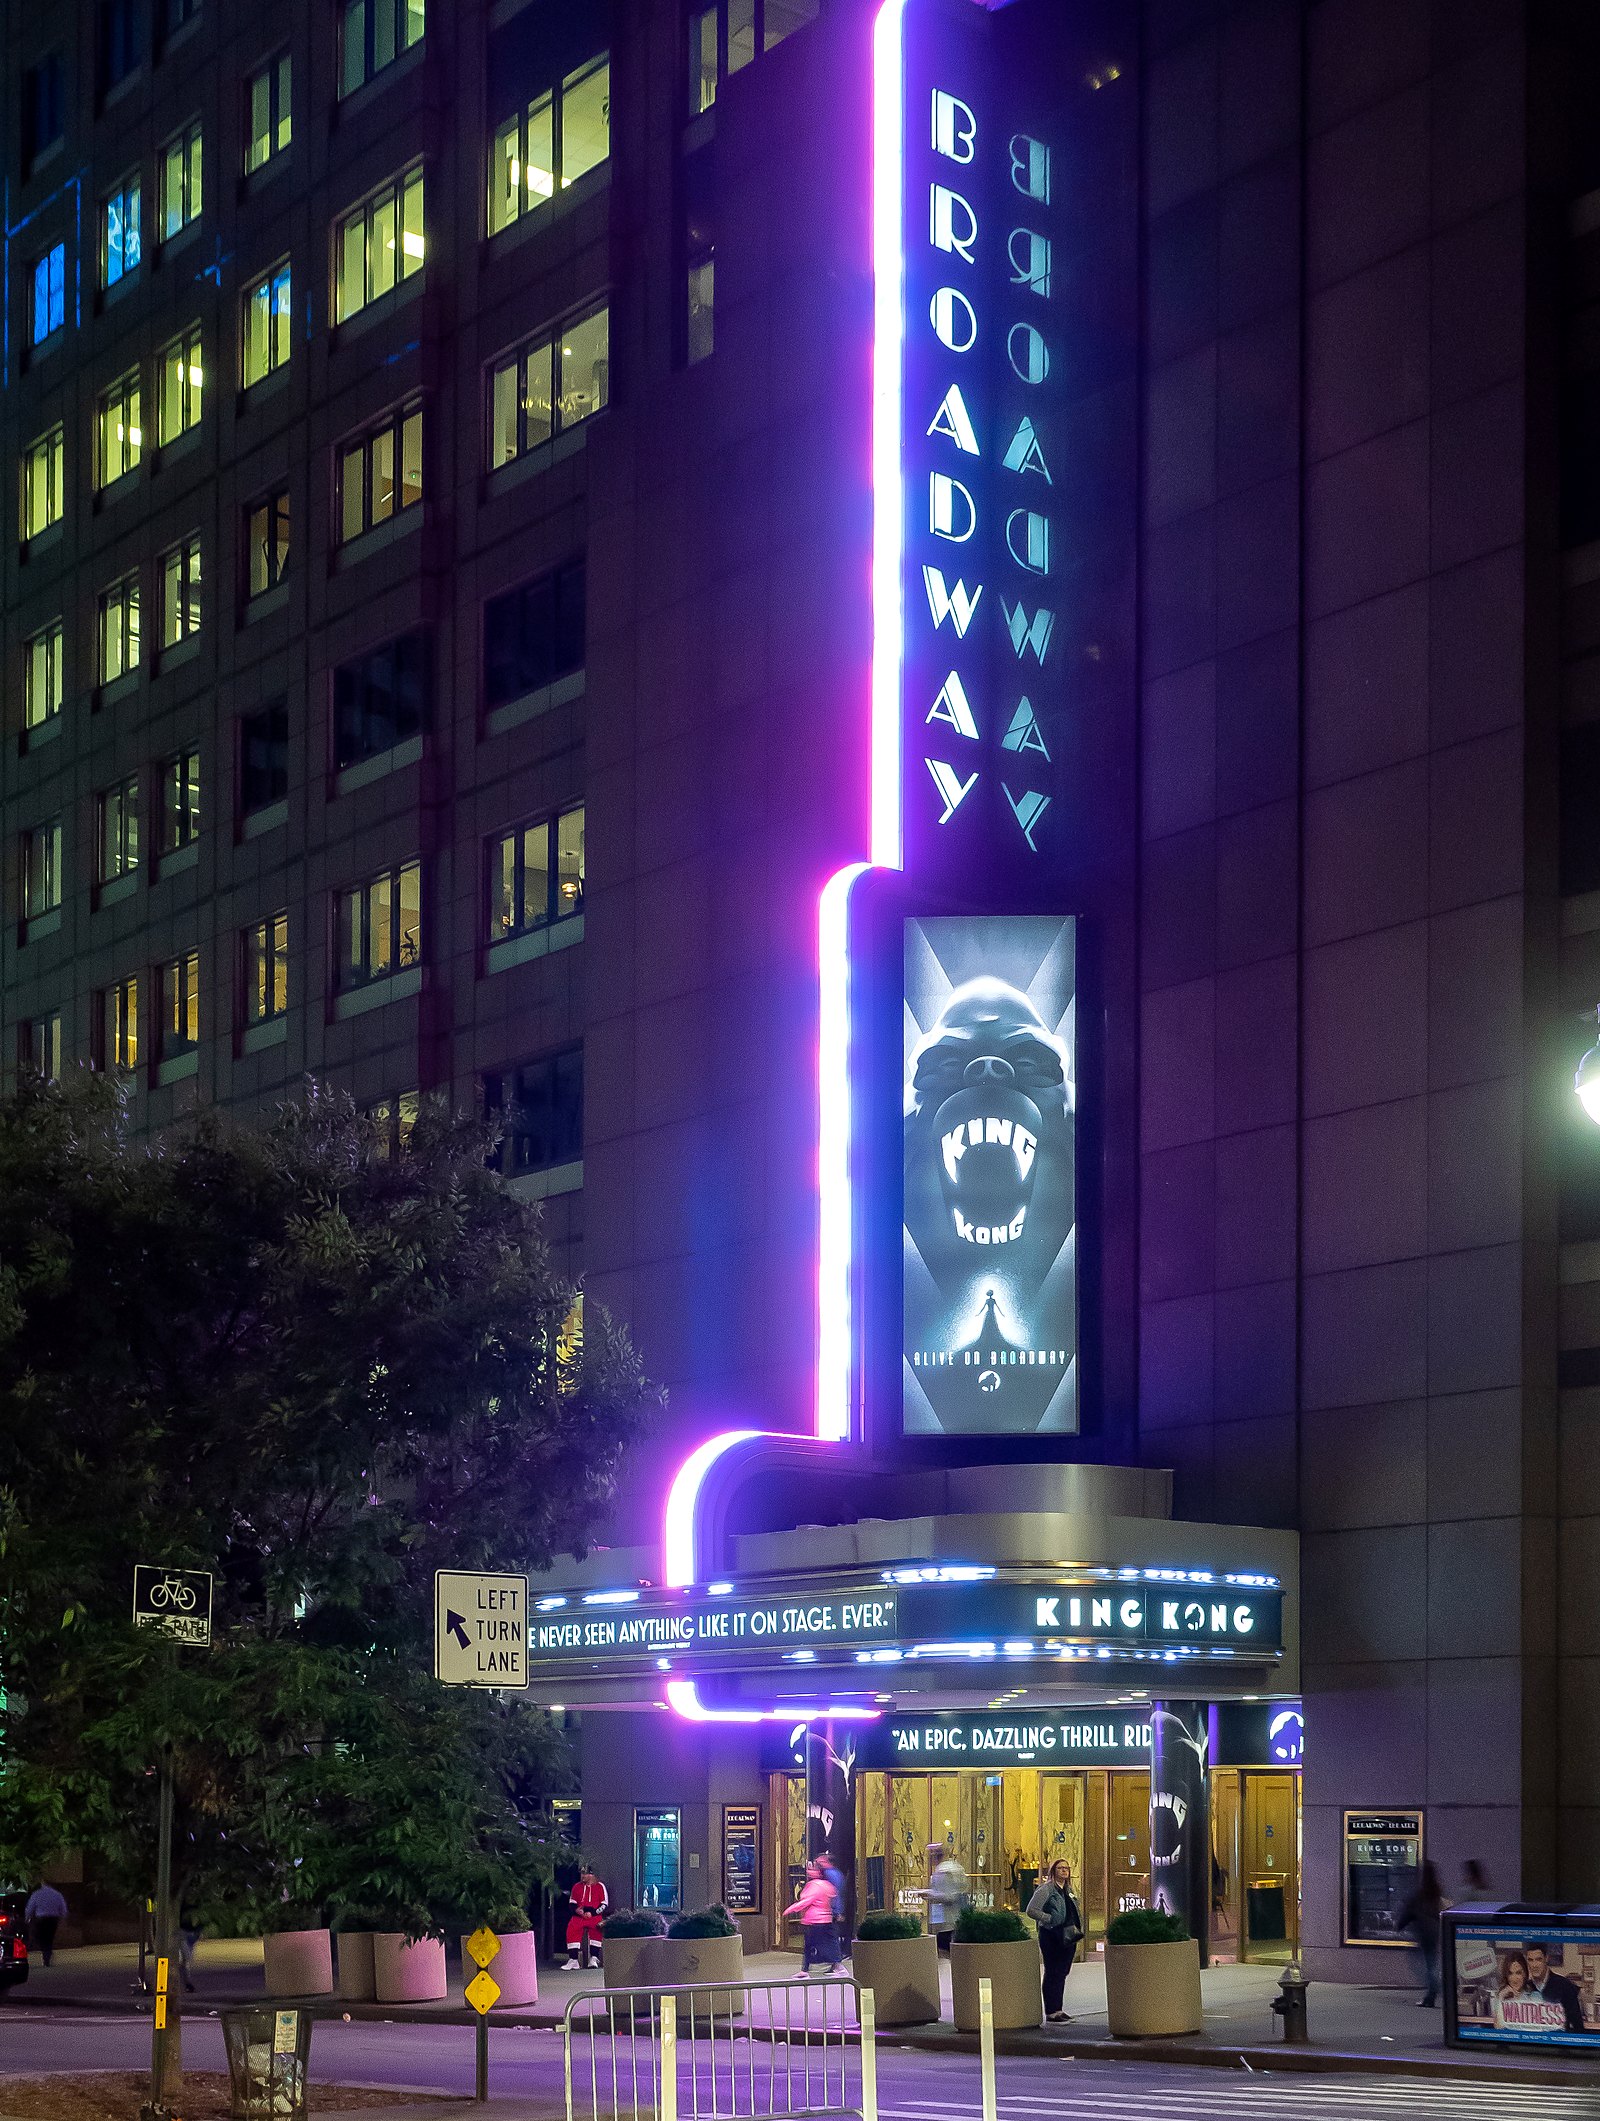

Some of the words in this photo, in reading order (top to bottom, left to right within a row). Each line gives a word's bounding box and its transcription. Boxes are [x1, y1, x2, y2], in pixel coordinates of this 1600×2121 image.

[922, 87, 983, 825] BROADWAY
[941, 1116, 1037, 1184] KING
[953, 1205, 1026, 1245] KONG
[913, 1351, 954, 1366] ALIVE
[964, 1350, 981, 1366] ON
[990, 1350, 1066, 1366] BROADWAY
[477, 1589, 519, 1611] LEFT
[1036, 1597, 1143, 1629] KING
[1162, 1601, 1255, 1634] KONG
[476, 1619, 521, 1641] TURN
[540, 1623, 581, 1648] NEVER
[584, 1621, 615, 1645] SEEN
[619, 1616, 695, 1643] ANYTHING
[699, 1614, 729, 1637] LIKE
[733, 1612, 747, 1636] IT
[751, 1611, 778, 1635] ON
[782, 1606, 837, 1633] STAGE.
[477, 1650, 520, 1672] LANE
[925, 1728, 966, 1752] EPIC,
[972, 1726, 1056, 1750] DAZZLING
[1061, 1725, 1118, 1748] THRILL
[806, 1804, 834, 1837] ING
[1149, 1791, 1188, 1829] ING
[1502, 2002, 1567, 2026] WAITRESS
